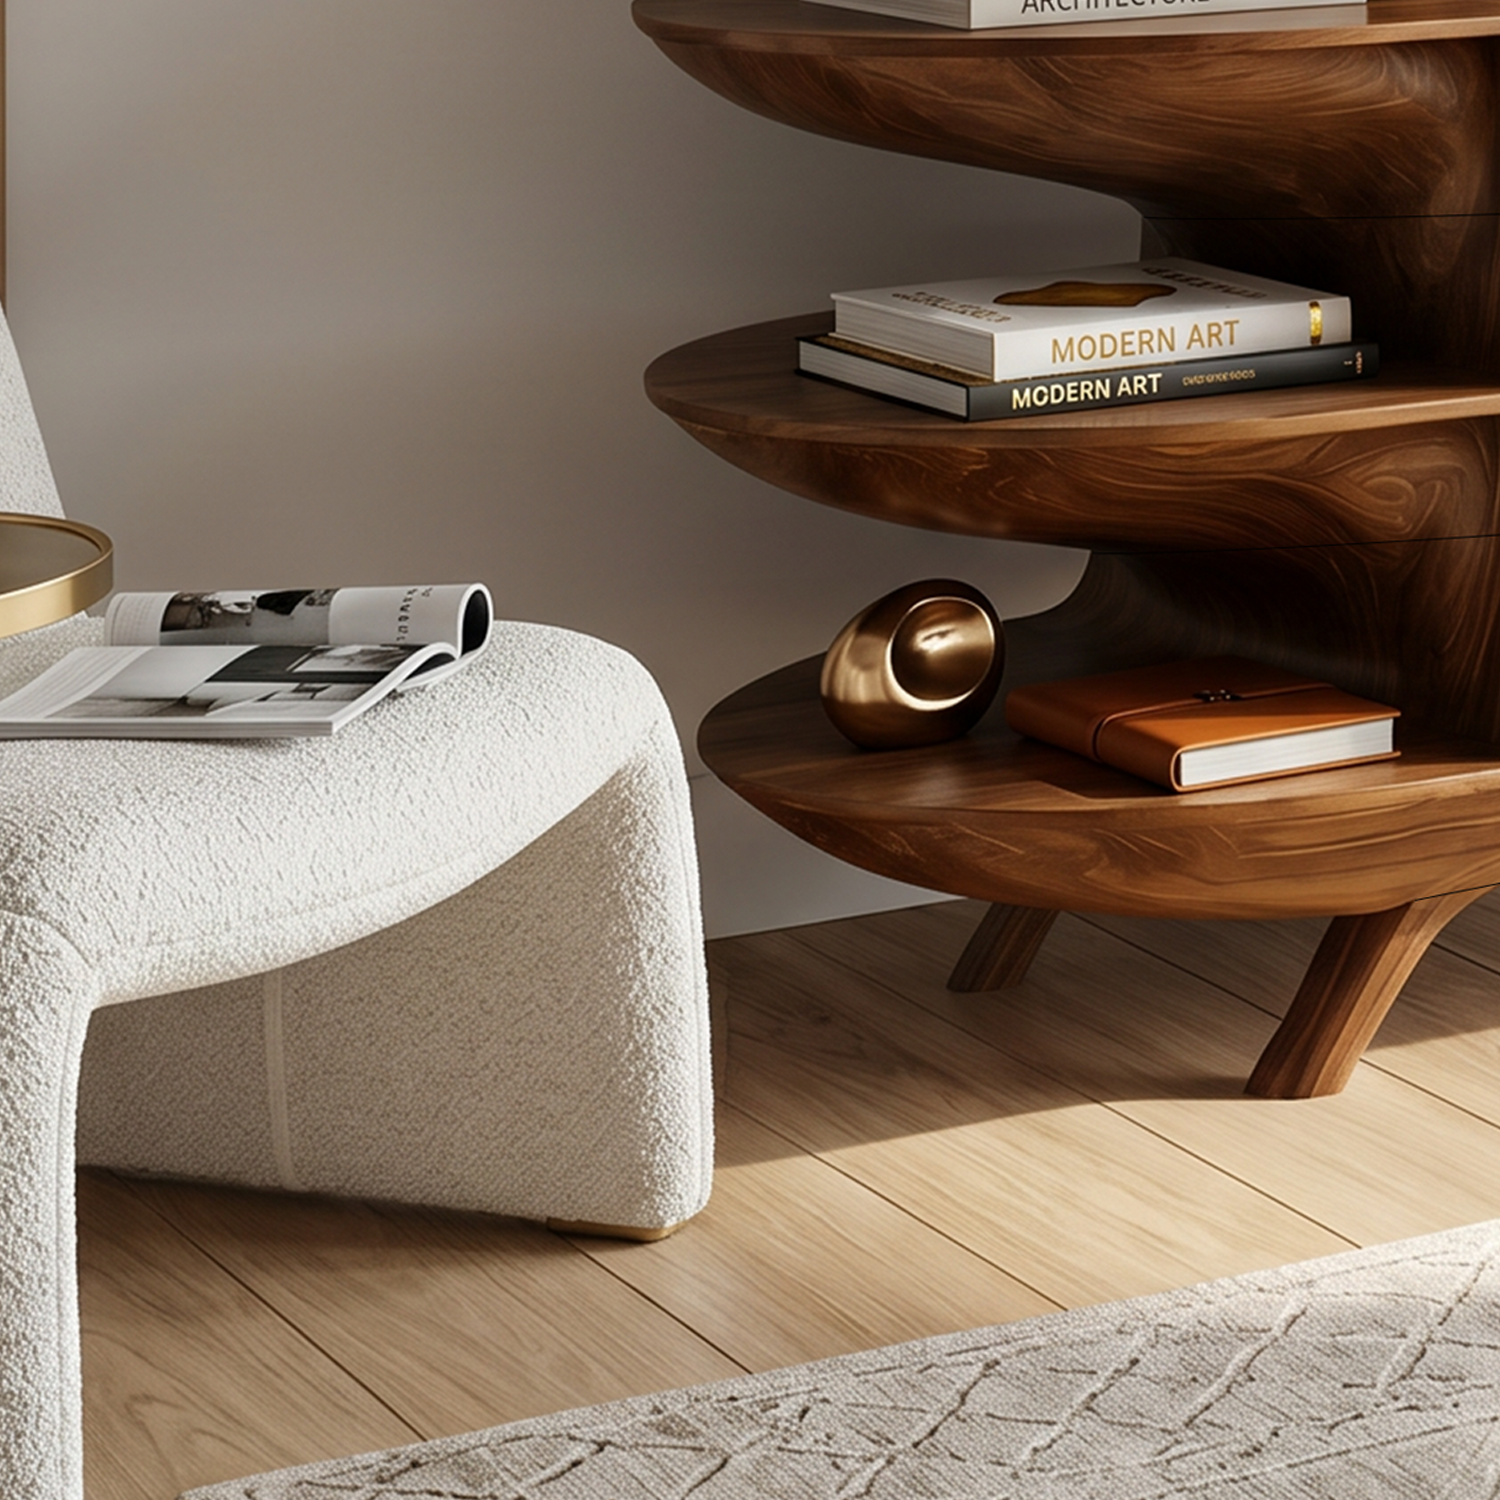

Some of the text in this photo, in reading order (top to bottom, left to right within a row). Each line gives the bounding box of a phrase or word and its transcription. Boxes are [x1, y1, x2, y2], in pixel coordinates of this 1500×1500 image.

[1050, 319, 1240, 364] MODERN ART
[1011, 377, 1111, 411] MODERN
[1116, 372, 1163, 398] ART
